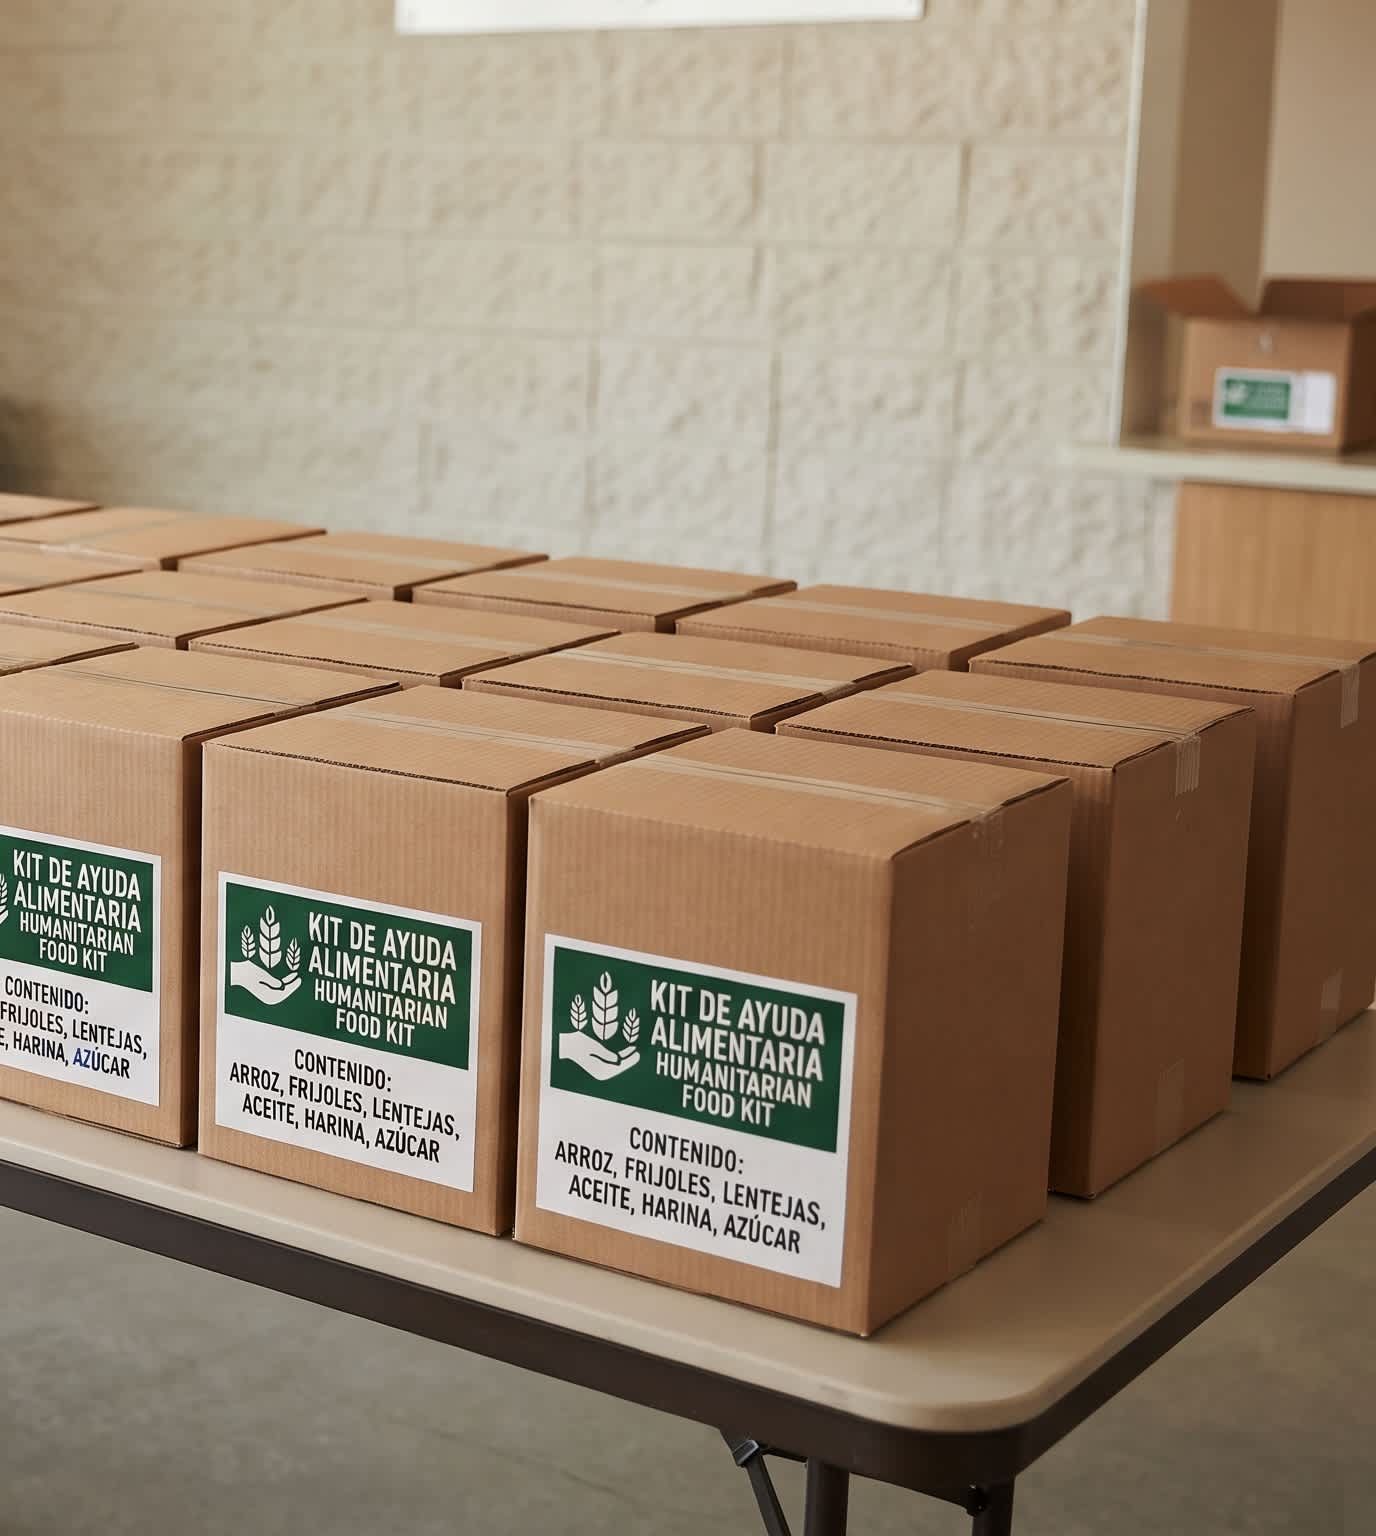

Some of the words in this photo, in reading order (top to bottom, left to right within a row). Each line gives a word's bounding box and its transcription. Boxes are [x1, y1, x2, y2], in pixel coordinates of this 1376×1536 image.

[13, 849, 43, 880] KIT
[49, 856, 72, 887] DE
[77, 863, 141, 900] AYUDA
[13, 881, 141, 931] ALIMENTARIA
[20, 911, 134, 954] HUMANITARIAN
[39, 938, 78, 965] FOOD
[82, 947, 108, 971] KIT
[308, 911, 343, 945] KIT
[350, 921, 376, 953] DE
[382, 928, 457, 970] AYUDA
[5, 975, 89, 1014] CONTENIDO:
[309, 946, 455, 1003] ALIMENTARIA
[314, 979, 447, 1028] HUMANITARIAN
[336, 1008, 381, 1038] FOOD
[386, 1019, 415, 1046] KIT
[651, 979, 693, 1016] KIT
[699, 989, 731, 1025] DE
[738, 999, 825, 1044] AYUDA
[0, 1000, 68, 1039] FRIJOLES,
[72, 1019, 147, 1059] LENTEJAS,
[13, 1030, 69, 1066] HARINA,
[72, 1046, 130, 1078] AZÚCAR
[651, 1017, 823, 1080] ALIMENTARIA
[294, 1049, 391, 1092] CONTENIDO:
[656, 1052, 812, 1106] HUMANITARIAN
[229, 1062, 284, 1097] ARROZ,
[289, 1075, 367, 1118] FRIJOLES,
[372, 1096, 460, 1140] LENTEJAS,
[682, 1084, 735, 1117] FOOD
[741, 1097, 775, 1126] KIT
[242, 1093, 299, 1129] ACEITE,
[304, 1107, 370, 1147] HARINA,
[374, 1126, 440, 1162] AZÚCAR
[629, 1126, 744, 1174] CONTENIDO:
[554, 1140, 617, 1178] ARROZ,
[625, 1156, 715, 1203] FRIJOLES,
[723, 1181, 826, 1230] LENTEJAS,
[568, 1174, 635, 1215] ACEITE,
[642, 1192, 717, 1236] HARINA,
[723, 1214, 801, 1253] AZÚCAR
